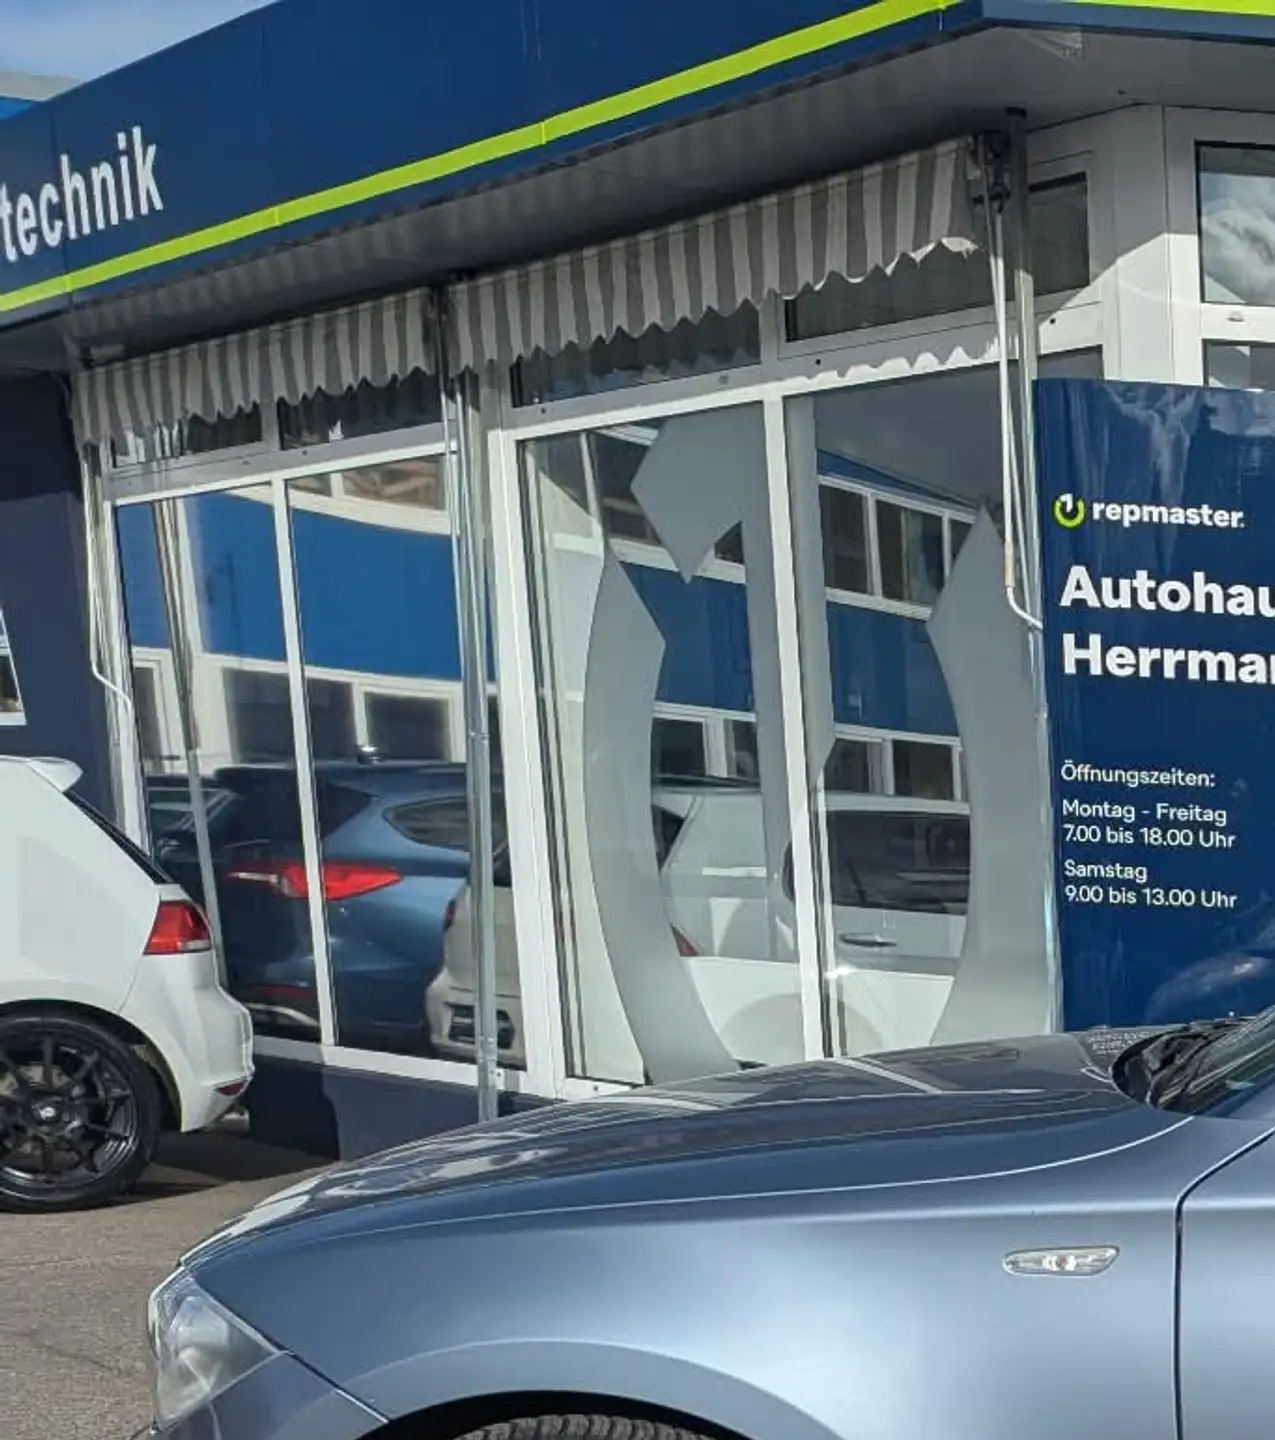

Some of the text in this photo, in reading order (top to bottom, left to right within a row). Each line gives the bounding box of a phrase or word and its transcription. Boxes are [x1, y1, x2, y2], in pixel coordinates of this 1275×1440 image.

[0, 125, 164, 263] technik
[1060, 759, 1216, 788] Öffnungszeiten:
[1062, 799, 1136, 823] Montag
[1156, 802, 1227, 827] Freitag
[1062, 824, 1237, 848] 7.00 bis 18.00 Uhr
[1064, 859, 1148, 884] Samstag
[1065, 885, 1238, 909] 9.00 bis 13.00 Uhr
